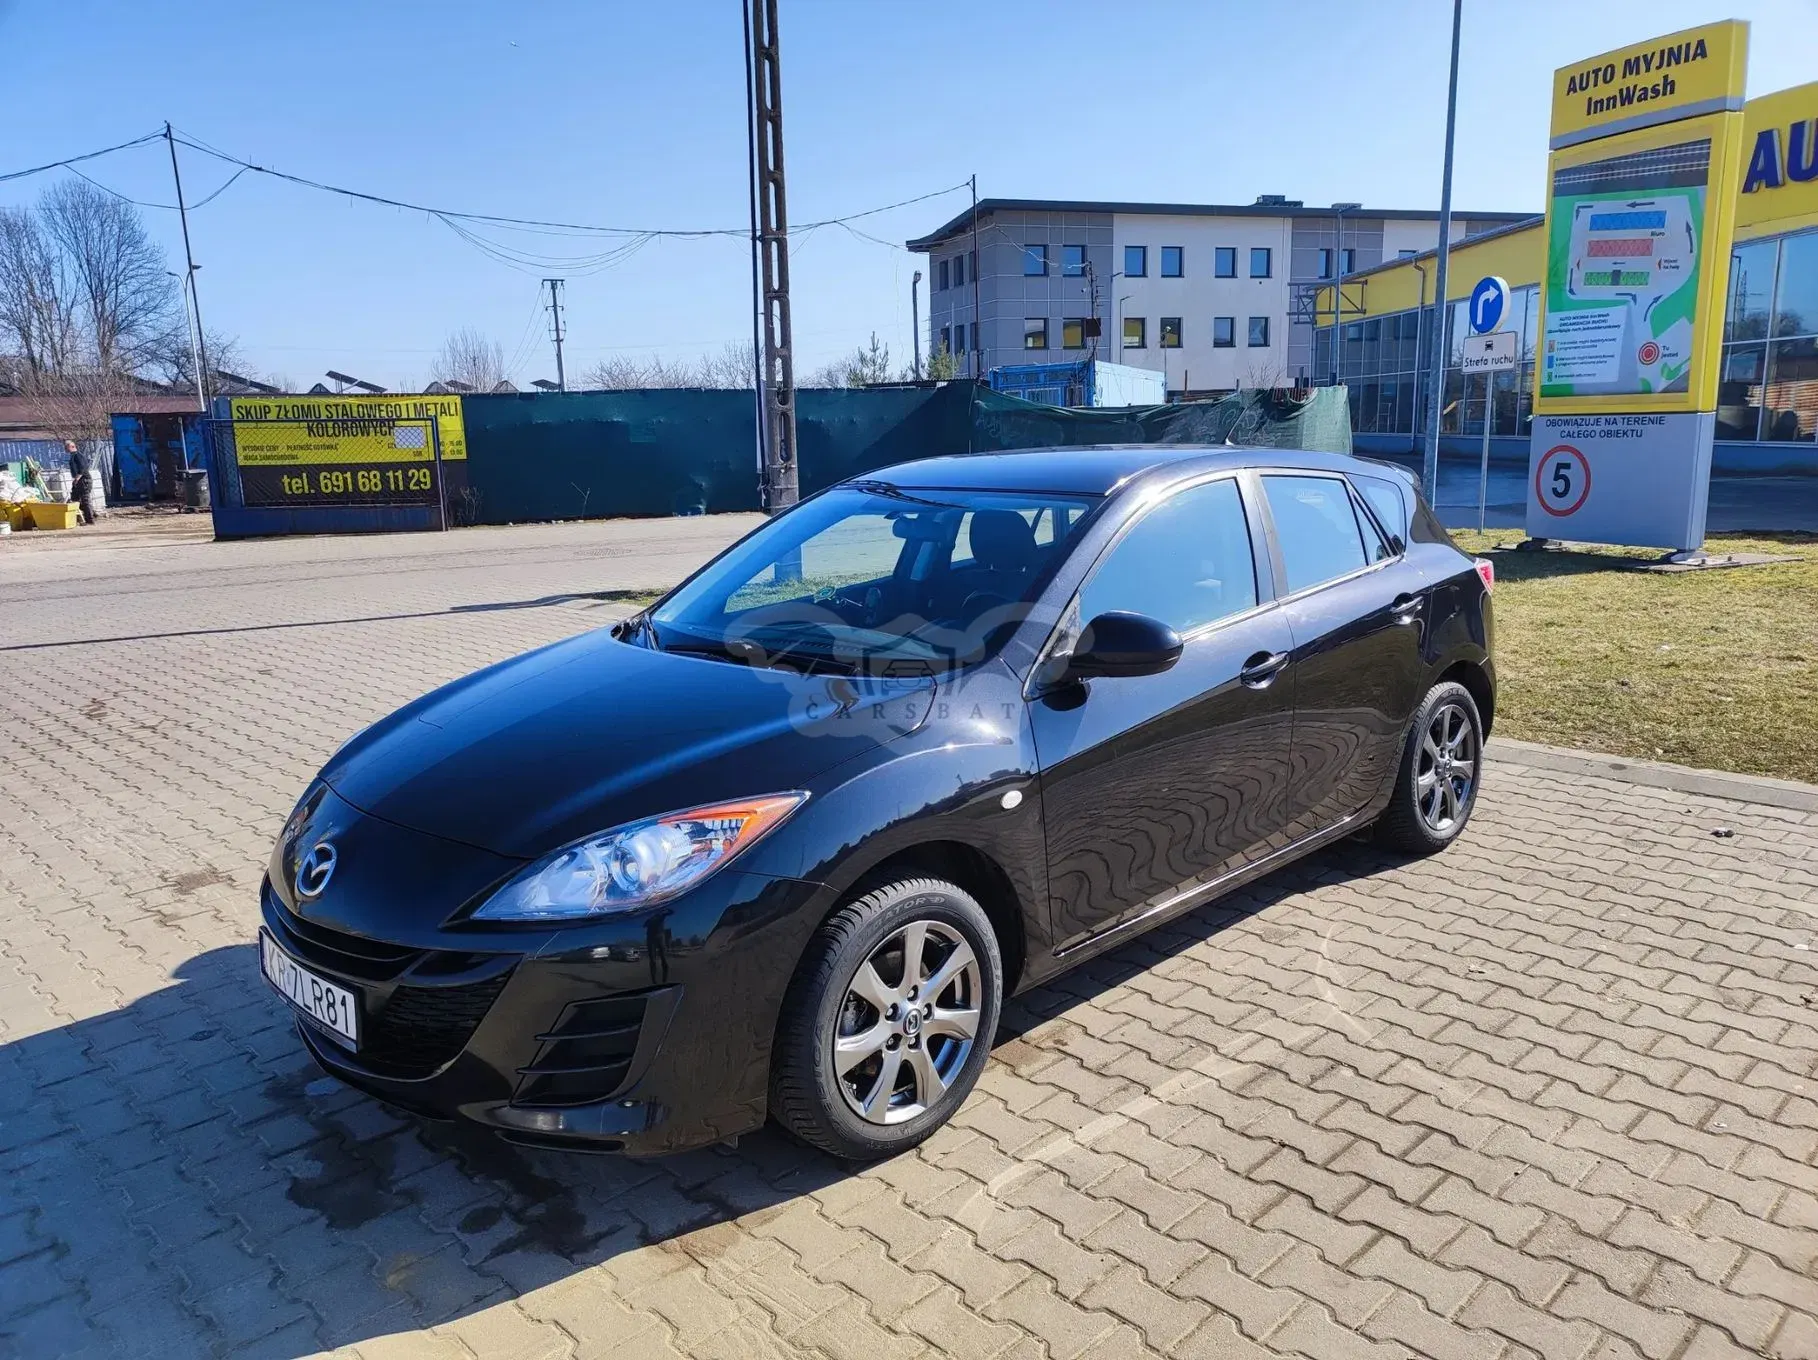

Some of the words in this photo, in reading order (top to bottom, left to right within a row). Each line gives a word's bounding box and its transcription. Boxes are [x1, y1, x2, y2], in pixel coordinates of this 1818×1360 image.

[1566, 63, 1615, 96] AUTO
[1622, 39, 1708, 79] MYJNIA
[1586, 74, 1676, 116] InnWash
[1741, 117, 1818, 194] AU
[1464, 356, 1489, 368] Strefa
[1491, 354, 1514, 365] ruchu
[236, 404, 272, 420] SKUP
[275, 404, 322, 420] ZŁOMU
[325, 403, 403, 419] STALOWEGO
[406, 403, 410, 418] I
[413, 402, 459, 418] METALI
[1545, 418, 1602, 429] OBOWIĄZUJE
[1604, 417, 1618, 426] NA
[1620, 416, 1666, 426] TERENIE
[306, 420, 396, 438] KOLOROWYCH
[1560, 429, 1597, 439] CAŁEGO
[1599, 429, 1643, 438] OBIEKTU
[282, 472, 316, 494] tel.
[319, 471, 353, 494] 691
[357, 470, 383, 492] 68
[386, 469, 404, 491] 11
[407, 468, 432, 490] 29
[1551, 462, 1571, 498] 5
[290, 964, 349, 1035] 7LR81
